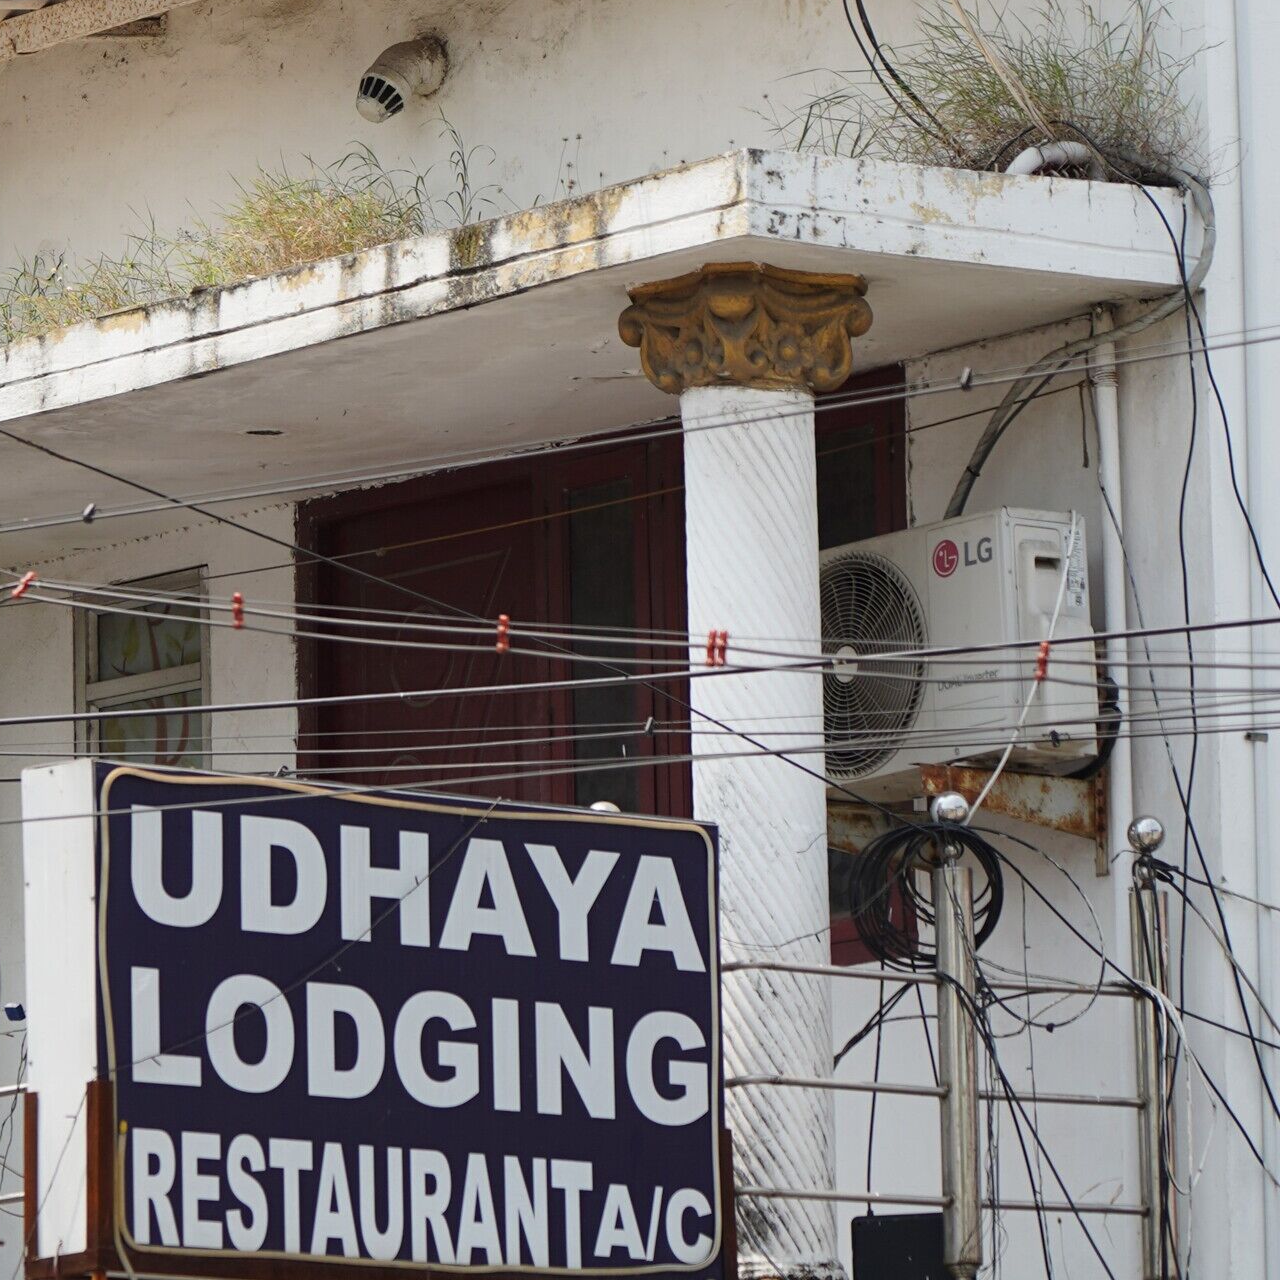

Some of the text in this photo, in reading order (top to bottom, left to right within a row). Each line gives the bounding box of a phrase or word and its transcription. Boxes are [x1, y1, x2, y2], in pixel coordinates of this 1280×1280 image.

[964, 537, 993, 567] LG
[130, 804, 706, 973] UDHAYA
[131, 966, 710, 1126] LODGING
[131, 1127, 713, 1270] RESTAURANT A/C
